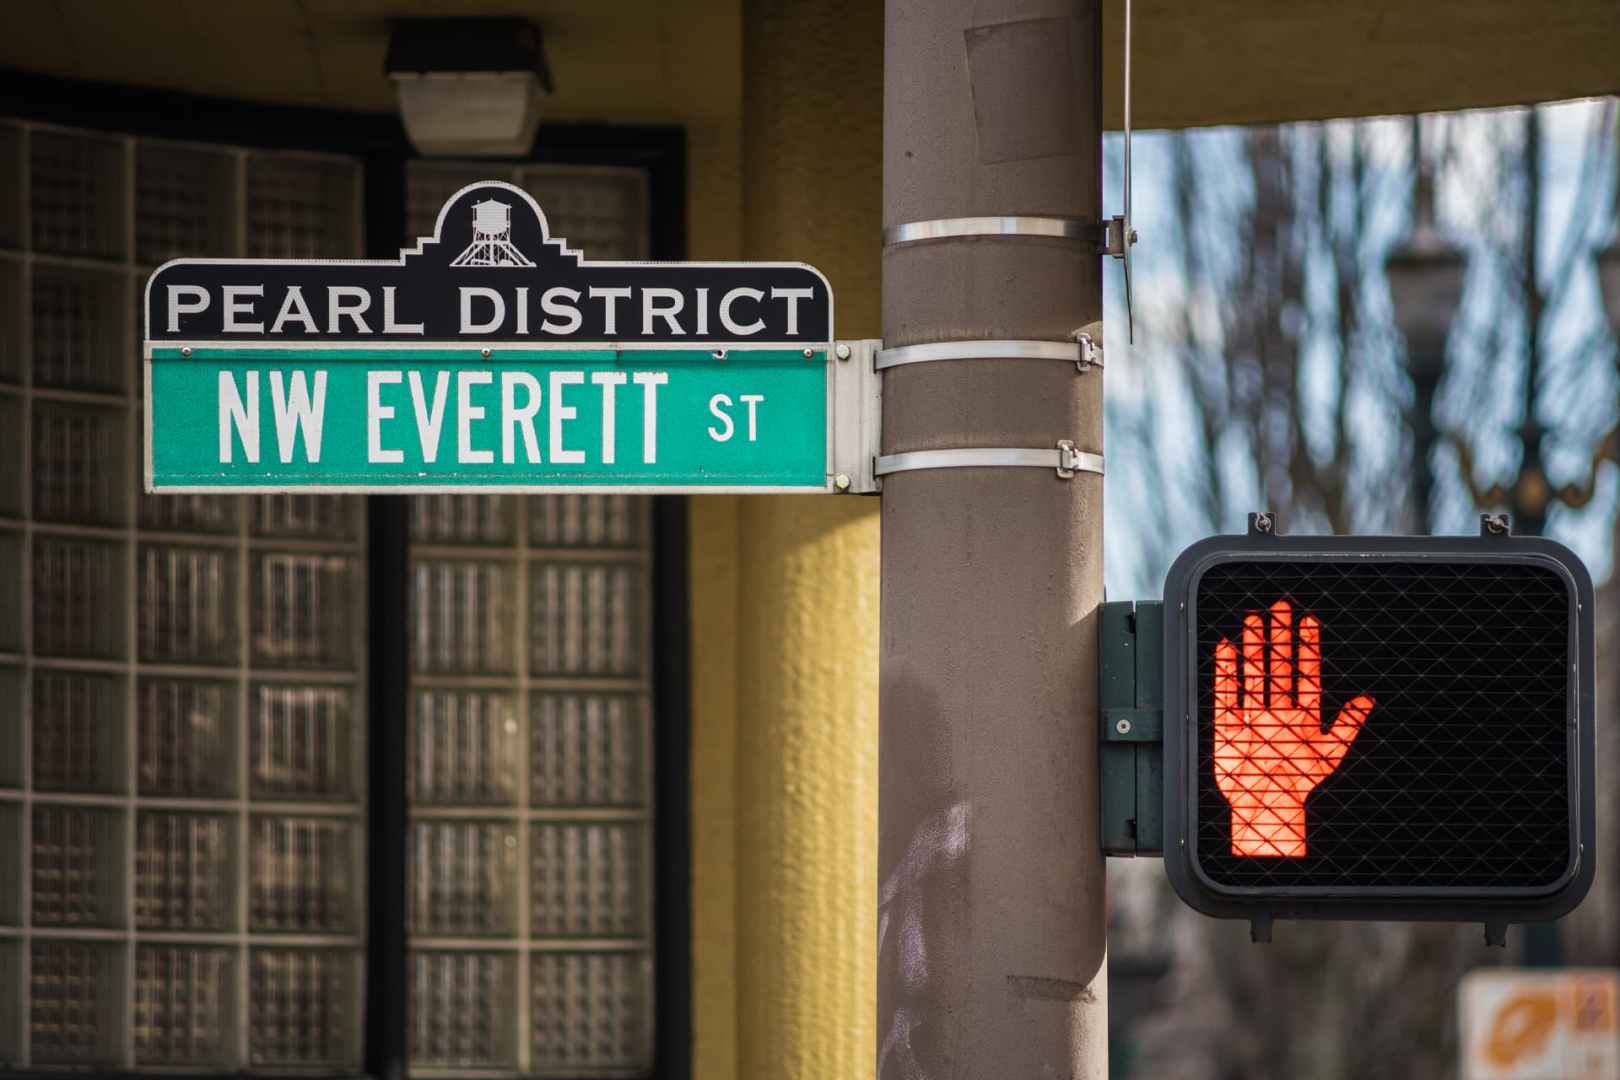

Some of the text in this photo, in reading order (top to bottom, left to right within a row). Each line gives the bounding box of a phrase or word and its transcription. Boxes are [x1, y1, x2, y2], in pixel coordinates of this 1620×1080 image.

[167, 285, 814, 336] PEARL DISTRICT
[219, 370, 764, 464] NW EVERETT ST
